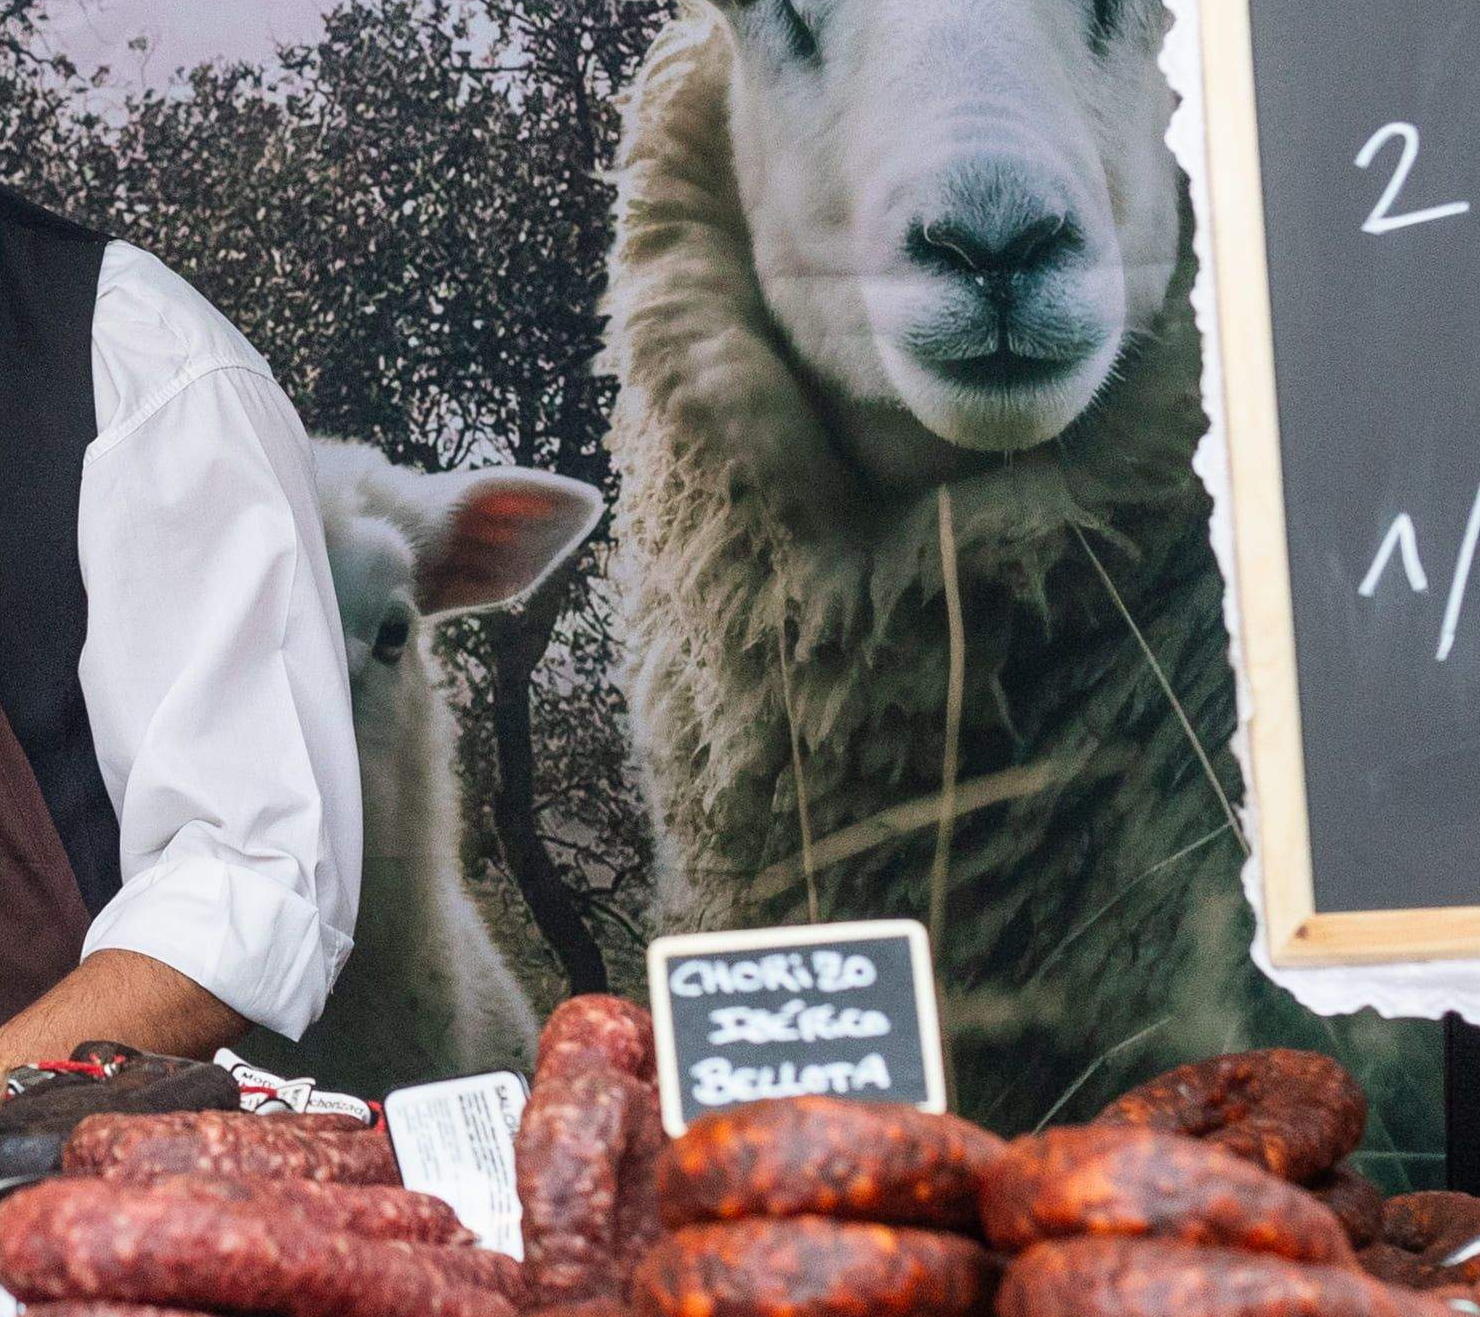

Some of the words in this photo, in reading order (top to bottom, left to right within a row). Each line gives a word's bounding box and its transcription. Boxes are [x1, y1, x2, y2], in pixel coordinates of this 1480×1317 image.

[1355, 121, 1470, 235] 2
[669, 950, 877, 997] CHORIZO
[689, 1052, 892, 1106] BELLOTA
